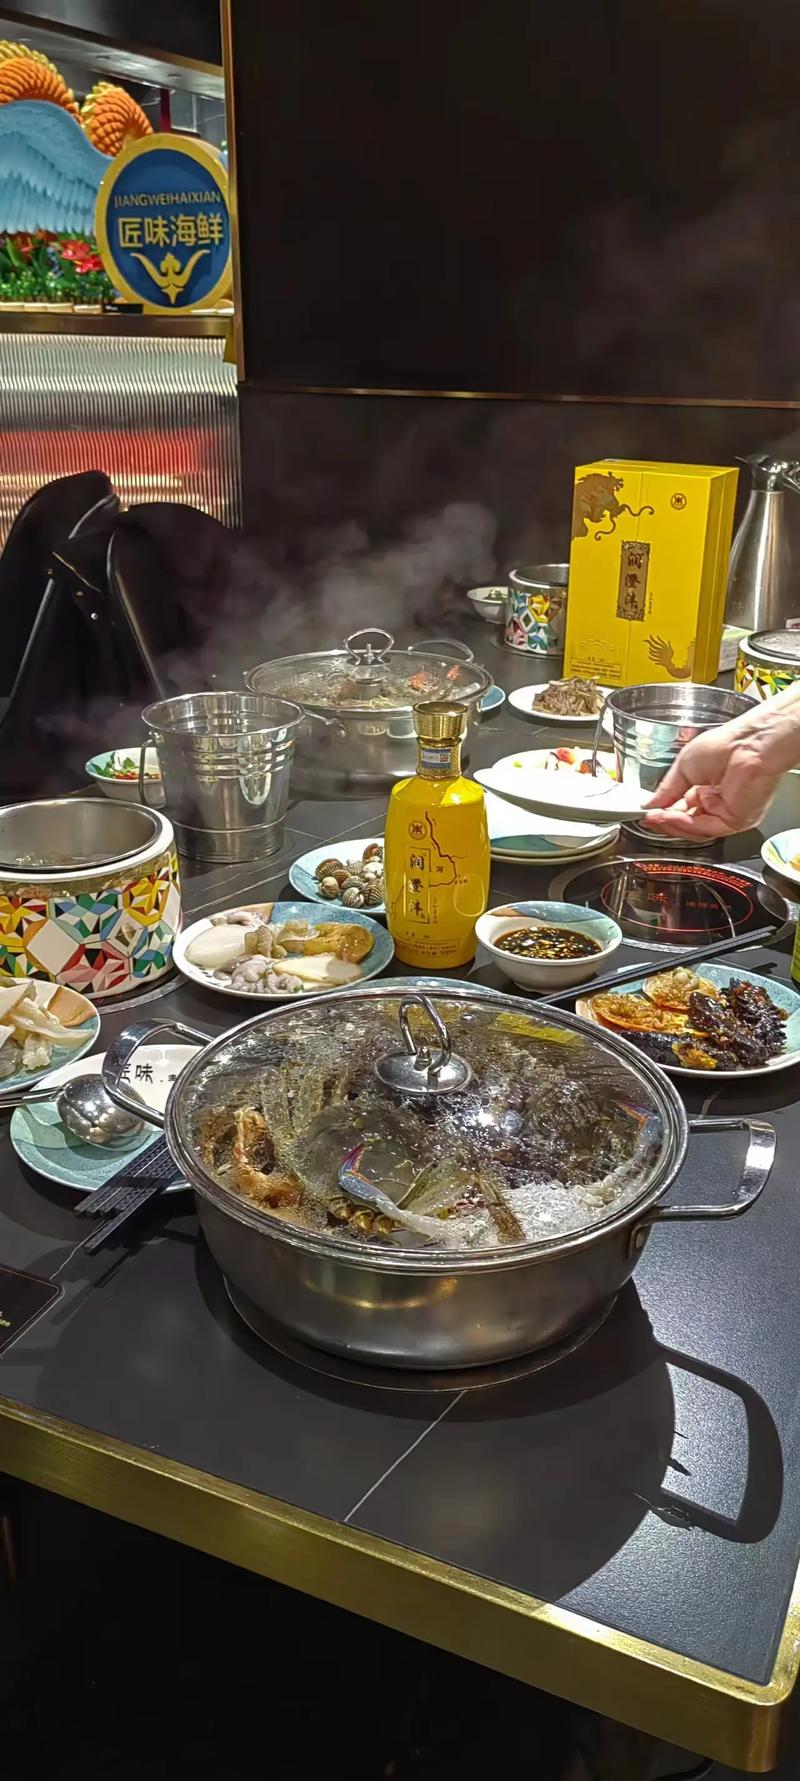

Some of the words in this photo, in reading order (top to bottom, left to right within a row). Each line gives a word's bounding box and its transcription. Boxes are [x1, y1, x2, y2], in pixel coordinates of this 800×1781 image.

[114, 191, 221, 209] JIANGWEIHAIXIAN
[118, 212, 224, 248] 匠味海鲜
